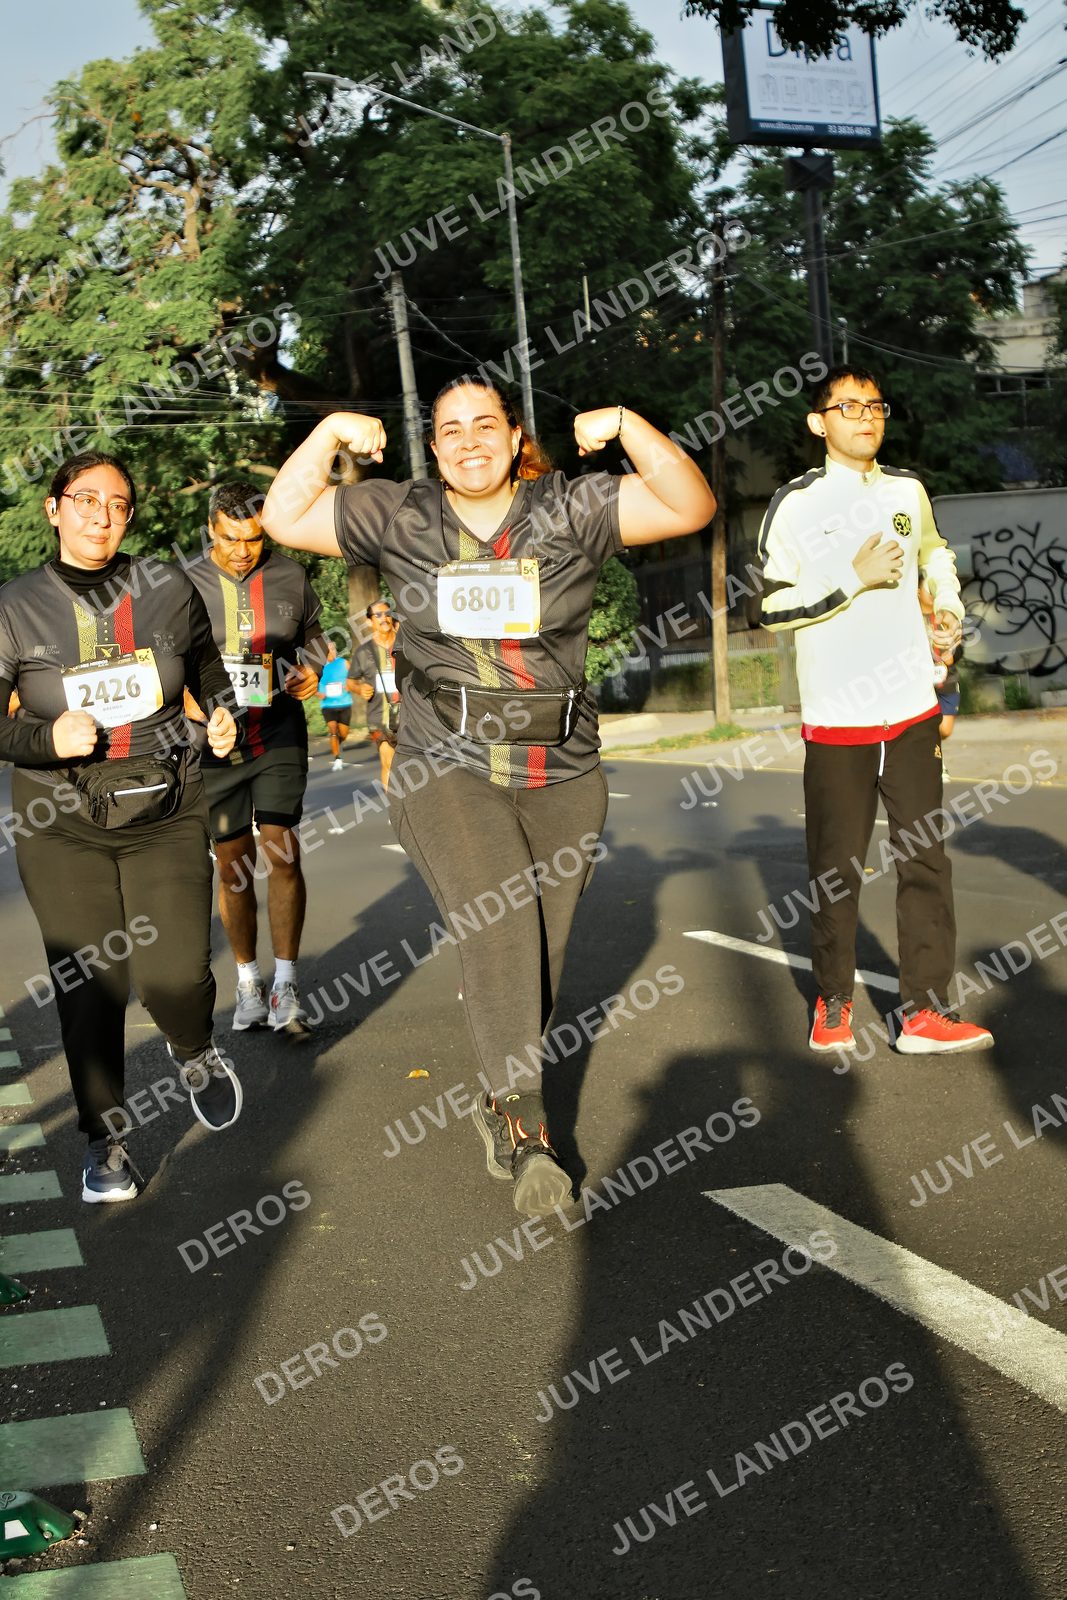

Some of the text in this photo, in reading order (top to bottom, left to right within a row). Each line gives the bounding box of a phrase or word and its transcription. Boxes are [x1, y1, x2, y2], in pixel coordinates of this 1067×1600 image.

[972, 521, 1041, 549] TOY
[451, 586, 515, 612] 6801
[78, 673, 141, 708] 2426
